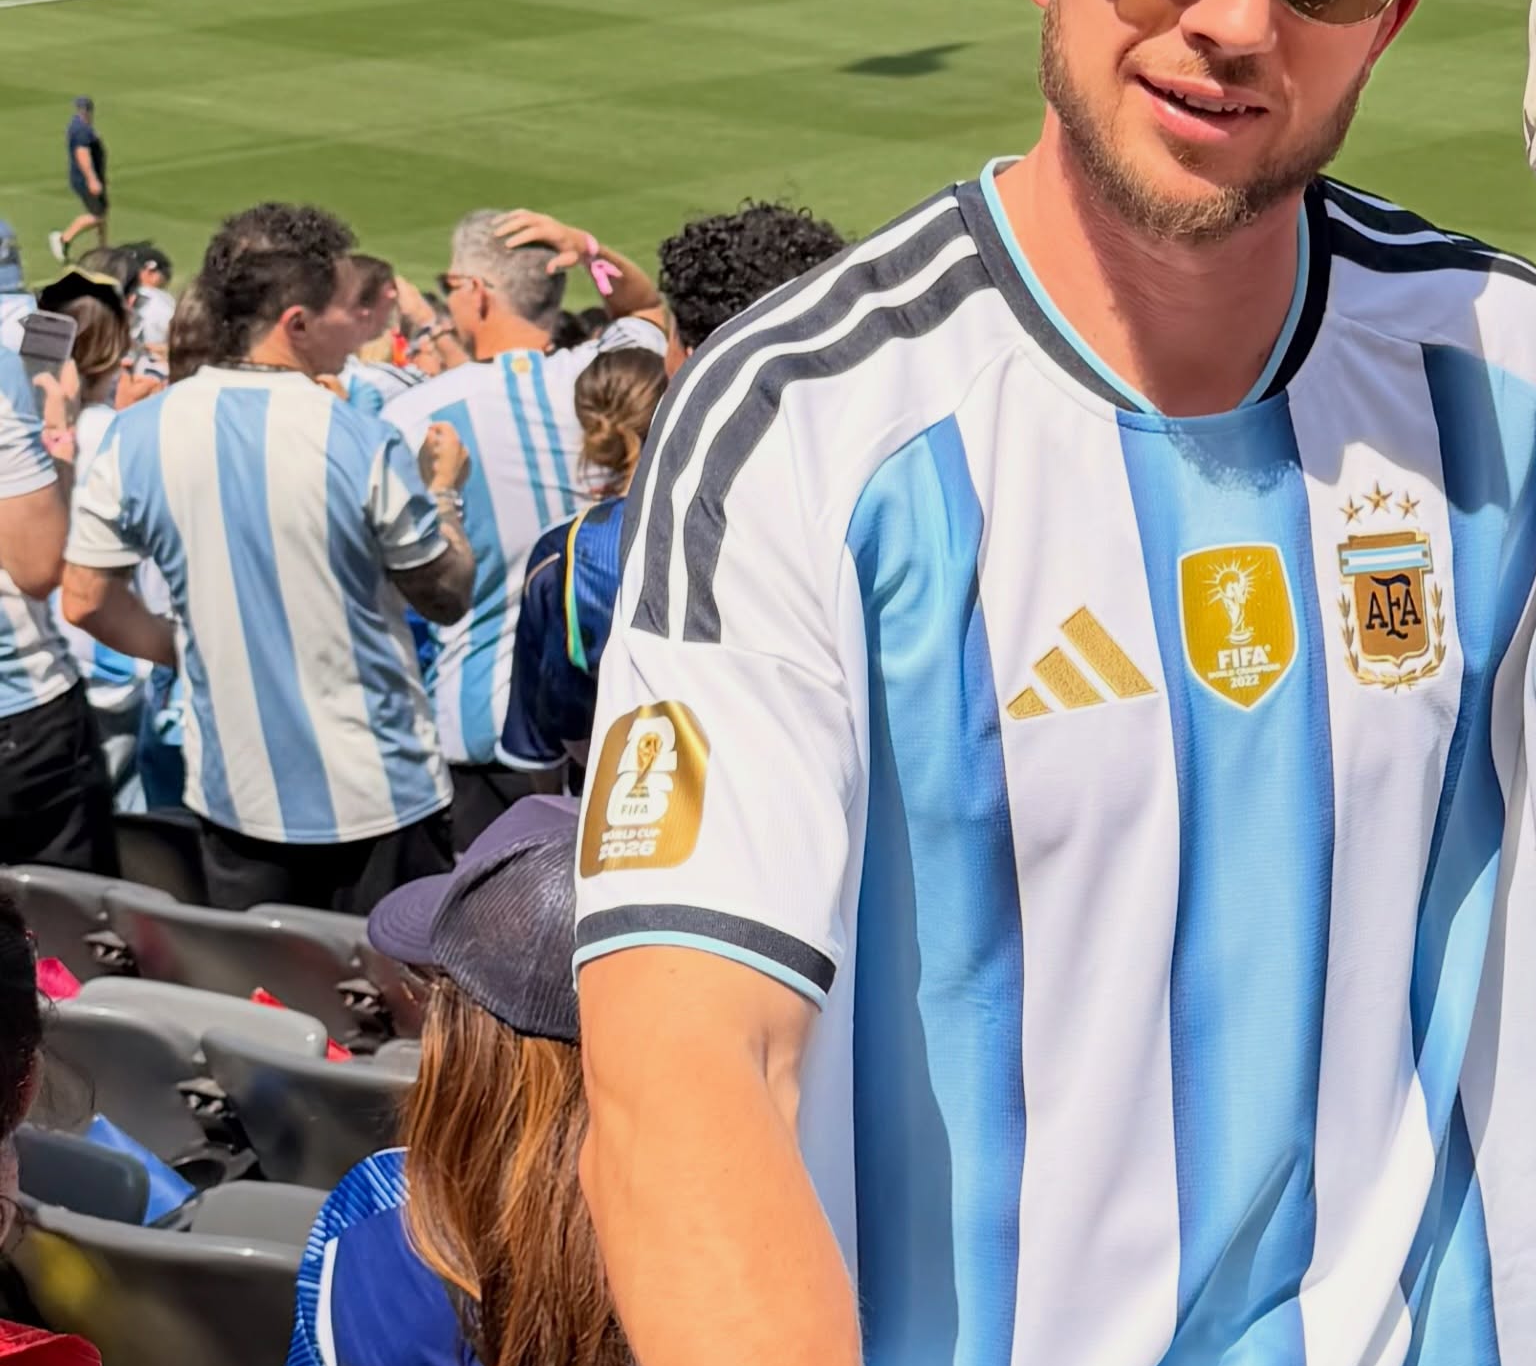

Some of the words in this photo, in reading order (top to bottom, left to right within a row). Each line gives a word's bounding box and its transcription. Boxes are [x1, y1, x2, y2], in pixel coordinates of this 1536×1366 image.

[1365, 573, 1422, 640] AFA
[1217, 644, 1270, 670] FIFA
[1230, 674, 1260, 690] 2022
[620, 803, 649, 816] FIFA
[637, 827, 662, 841] CUP
[598, 839, 658, 862] 2026
